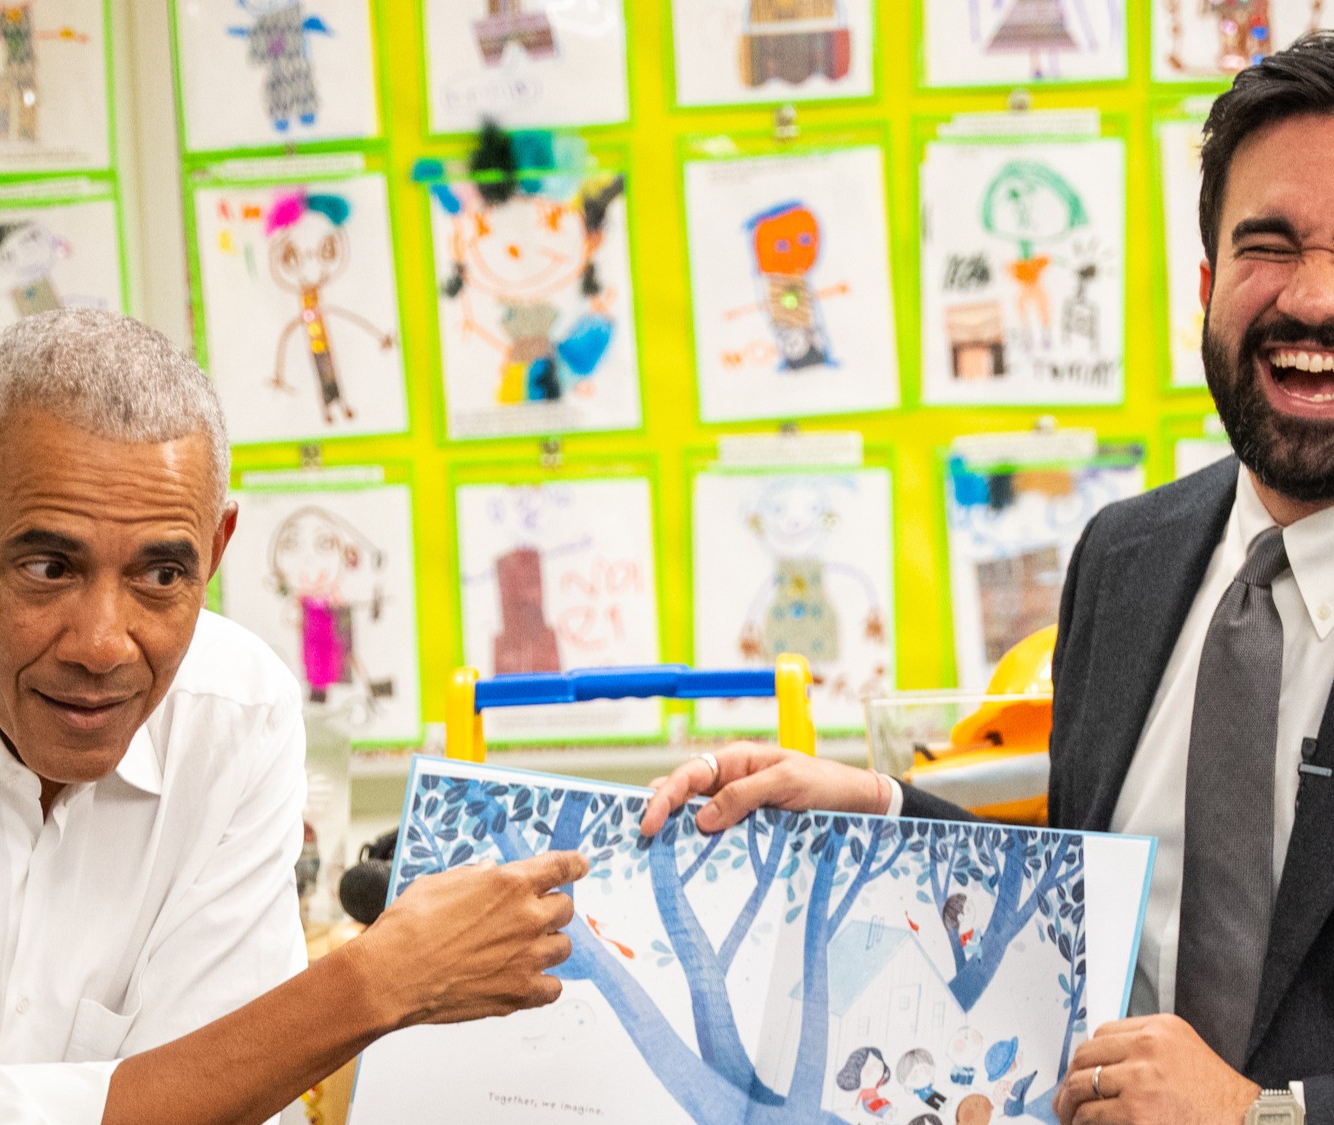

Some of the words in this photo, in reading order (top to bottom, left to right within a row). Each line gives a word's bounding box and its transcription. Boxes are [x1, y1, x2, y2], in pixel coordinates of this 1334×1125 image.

[488, 1092, 537, 1108] Together,
[542, 1101, 556, 1109] we
[561, 1103, 605, 1116] imagine.
